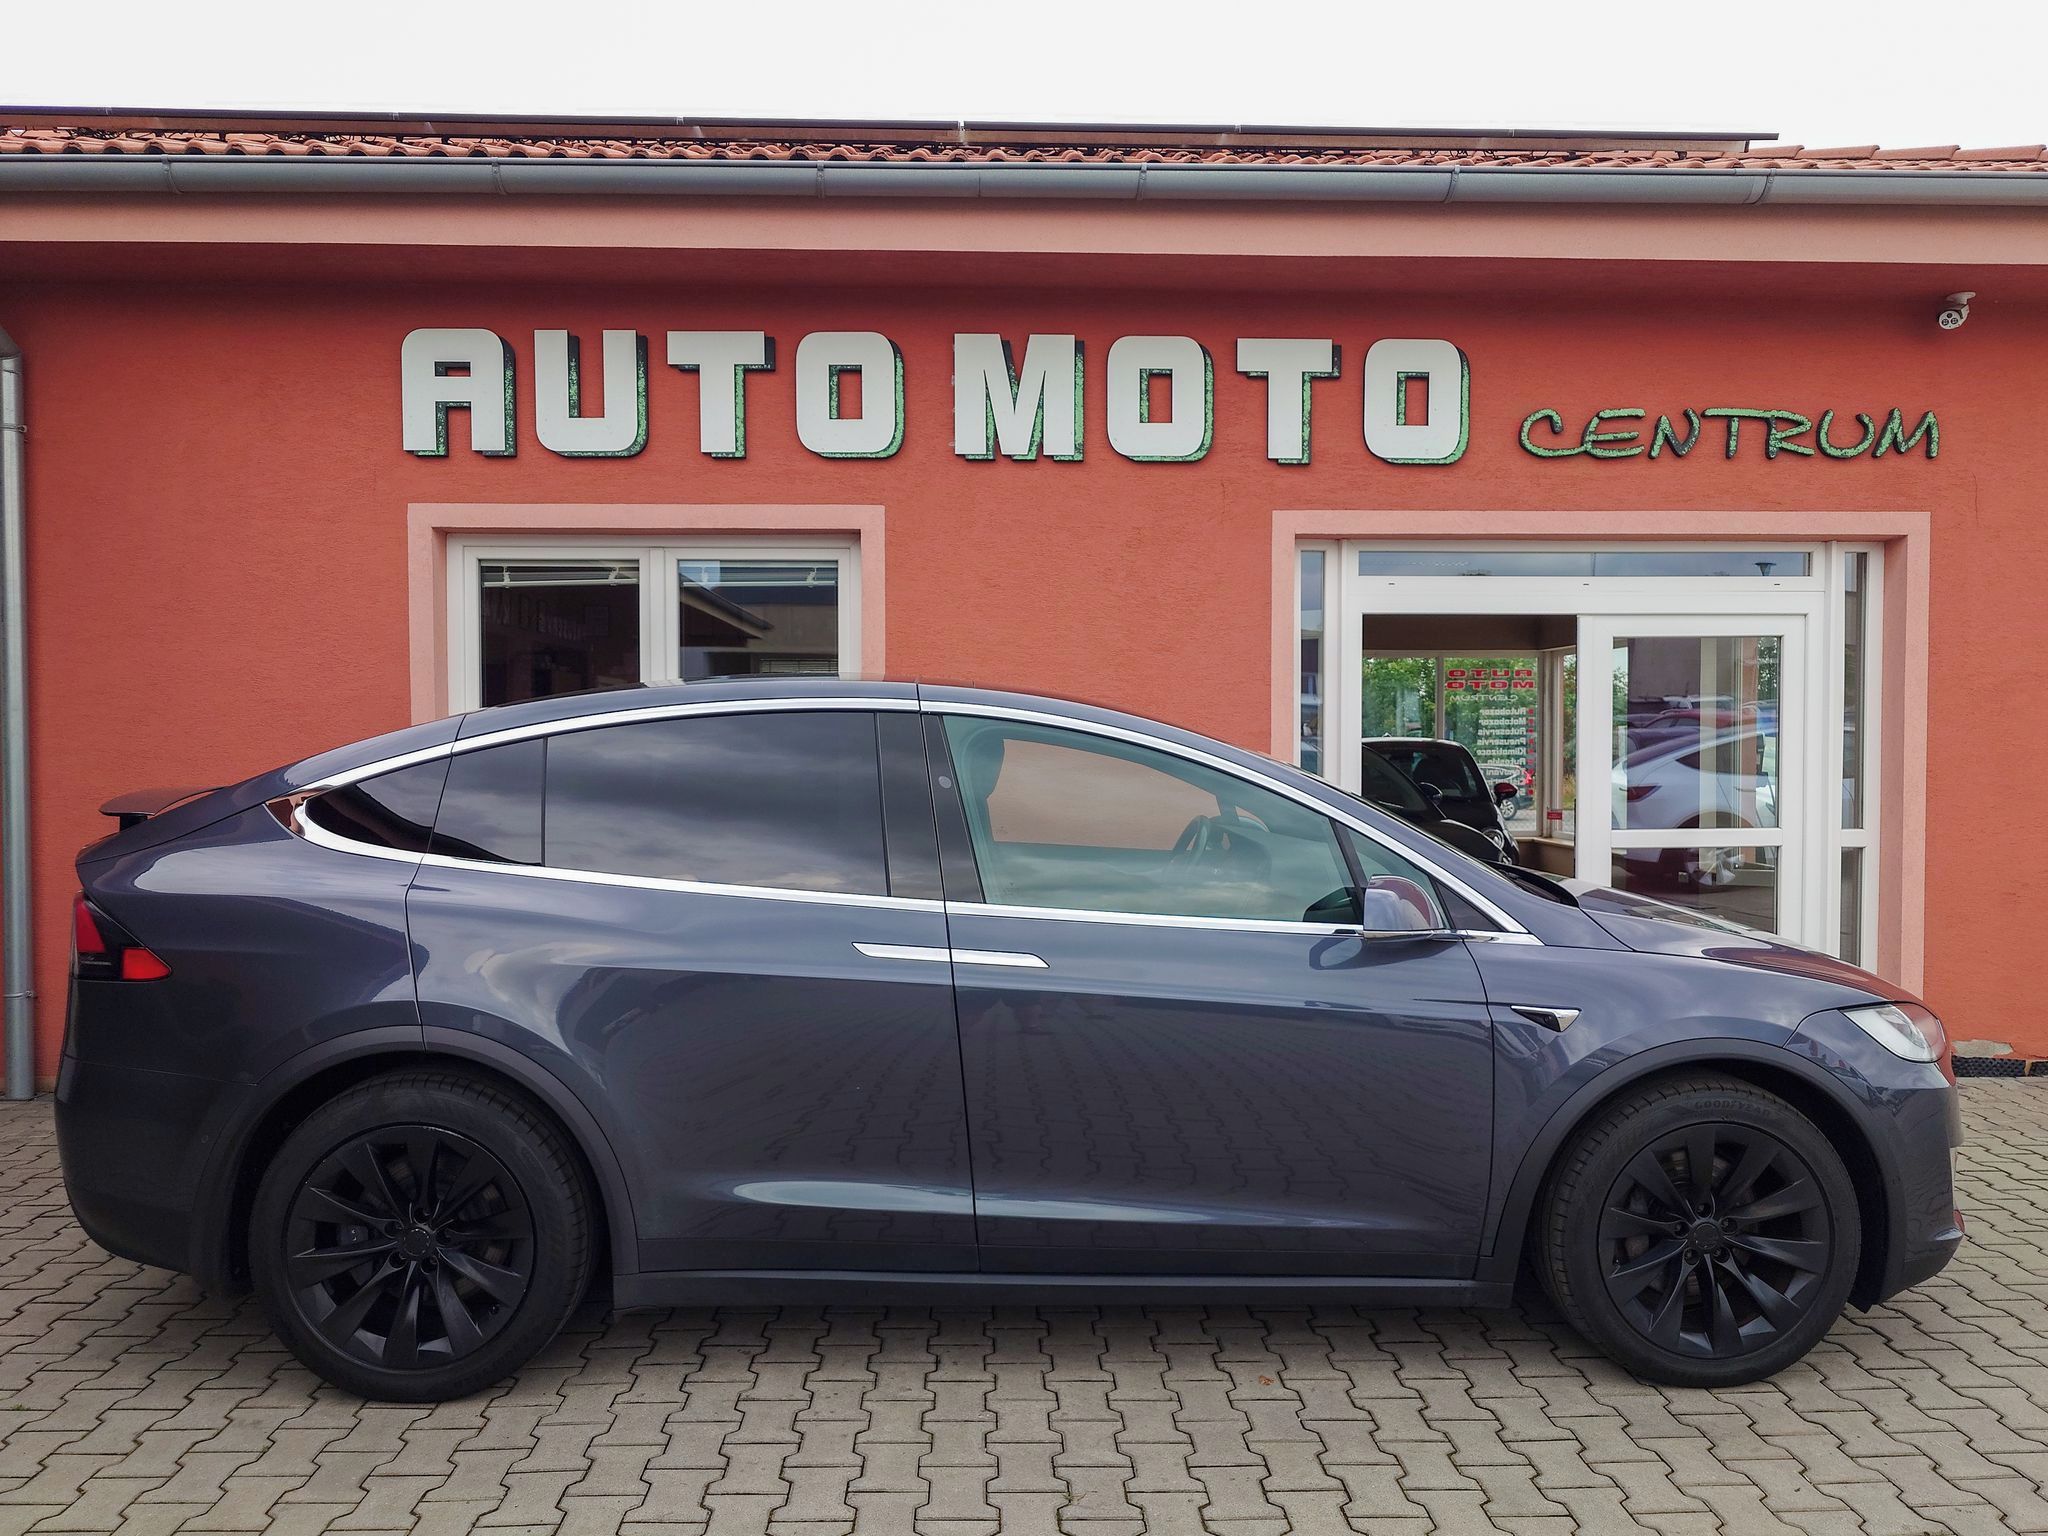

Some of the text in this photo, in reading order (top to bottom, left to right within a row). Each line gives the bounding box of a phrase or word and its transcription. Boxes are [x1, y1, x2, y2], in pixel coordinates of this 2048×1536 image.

[401, 327, 1940, 465] AUTO MOTO CENTRUM
